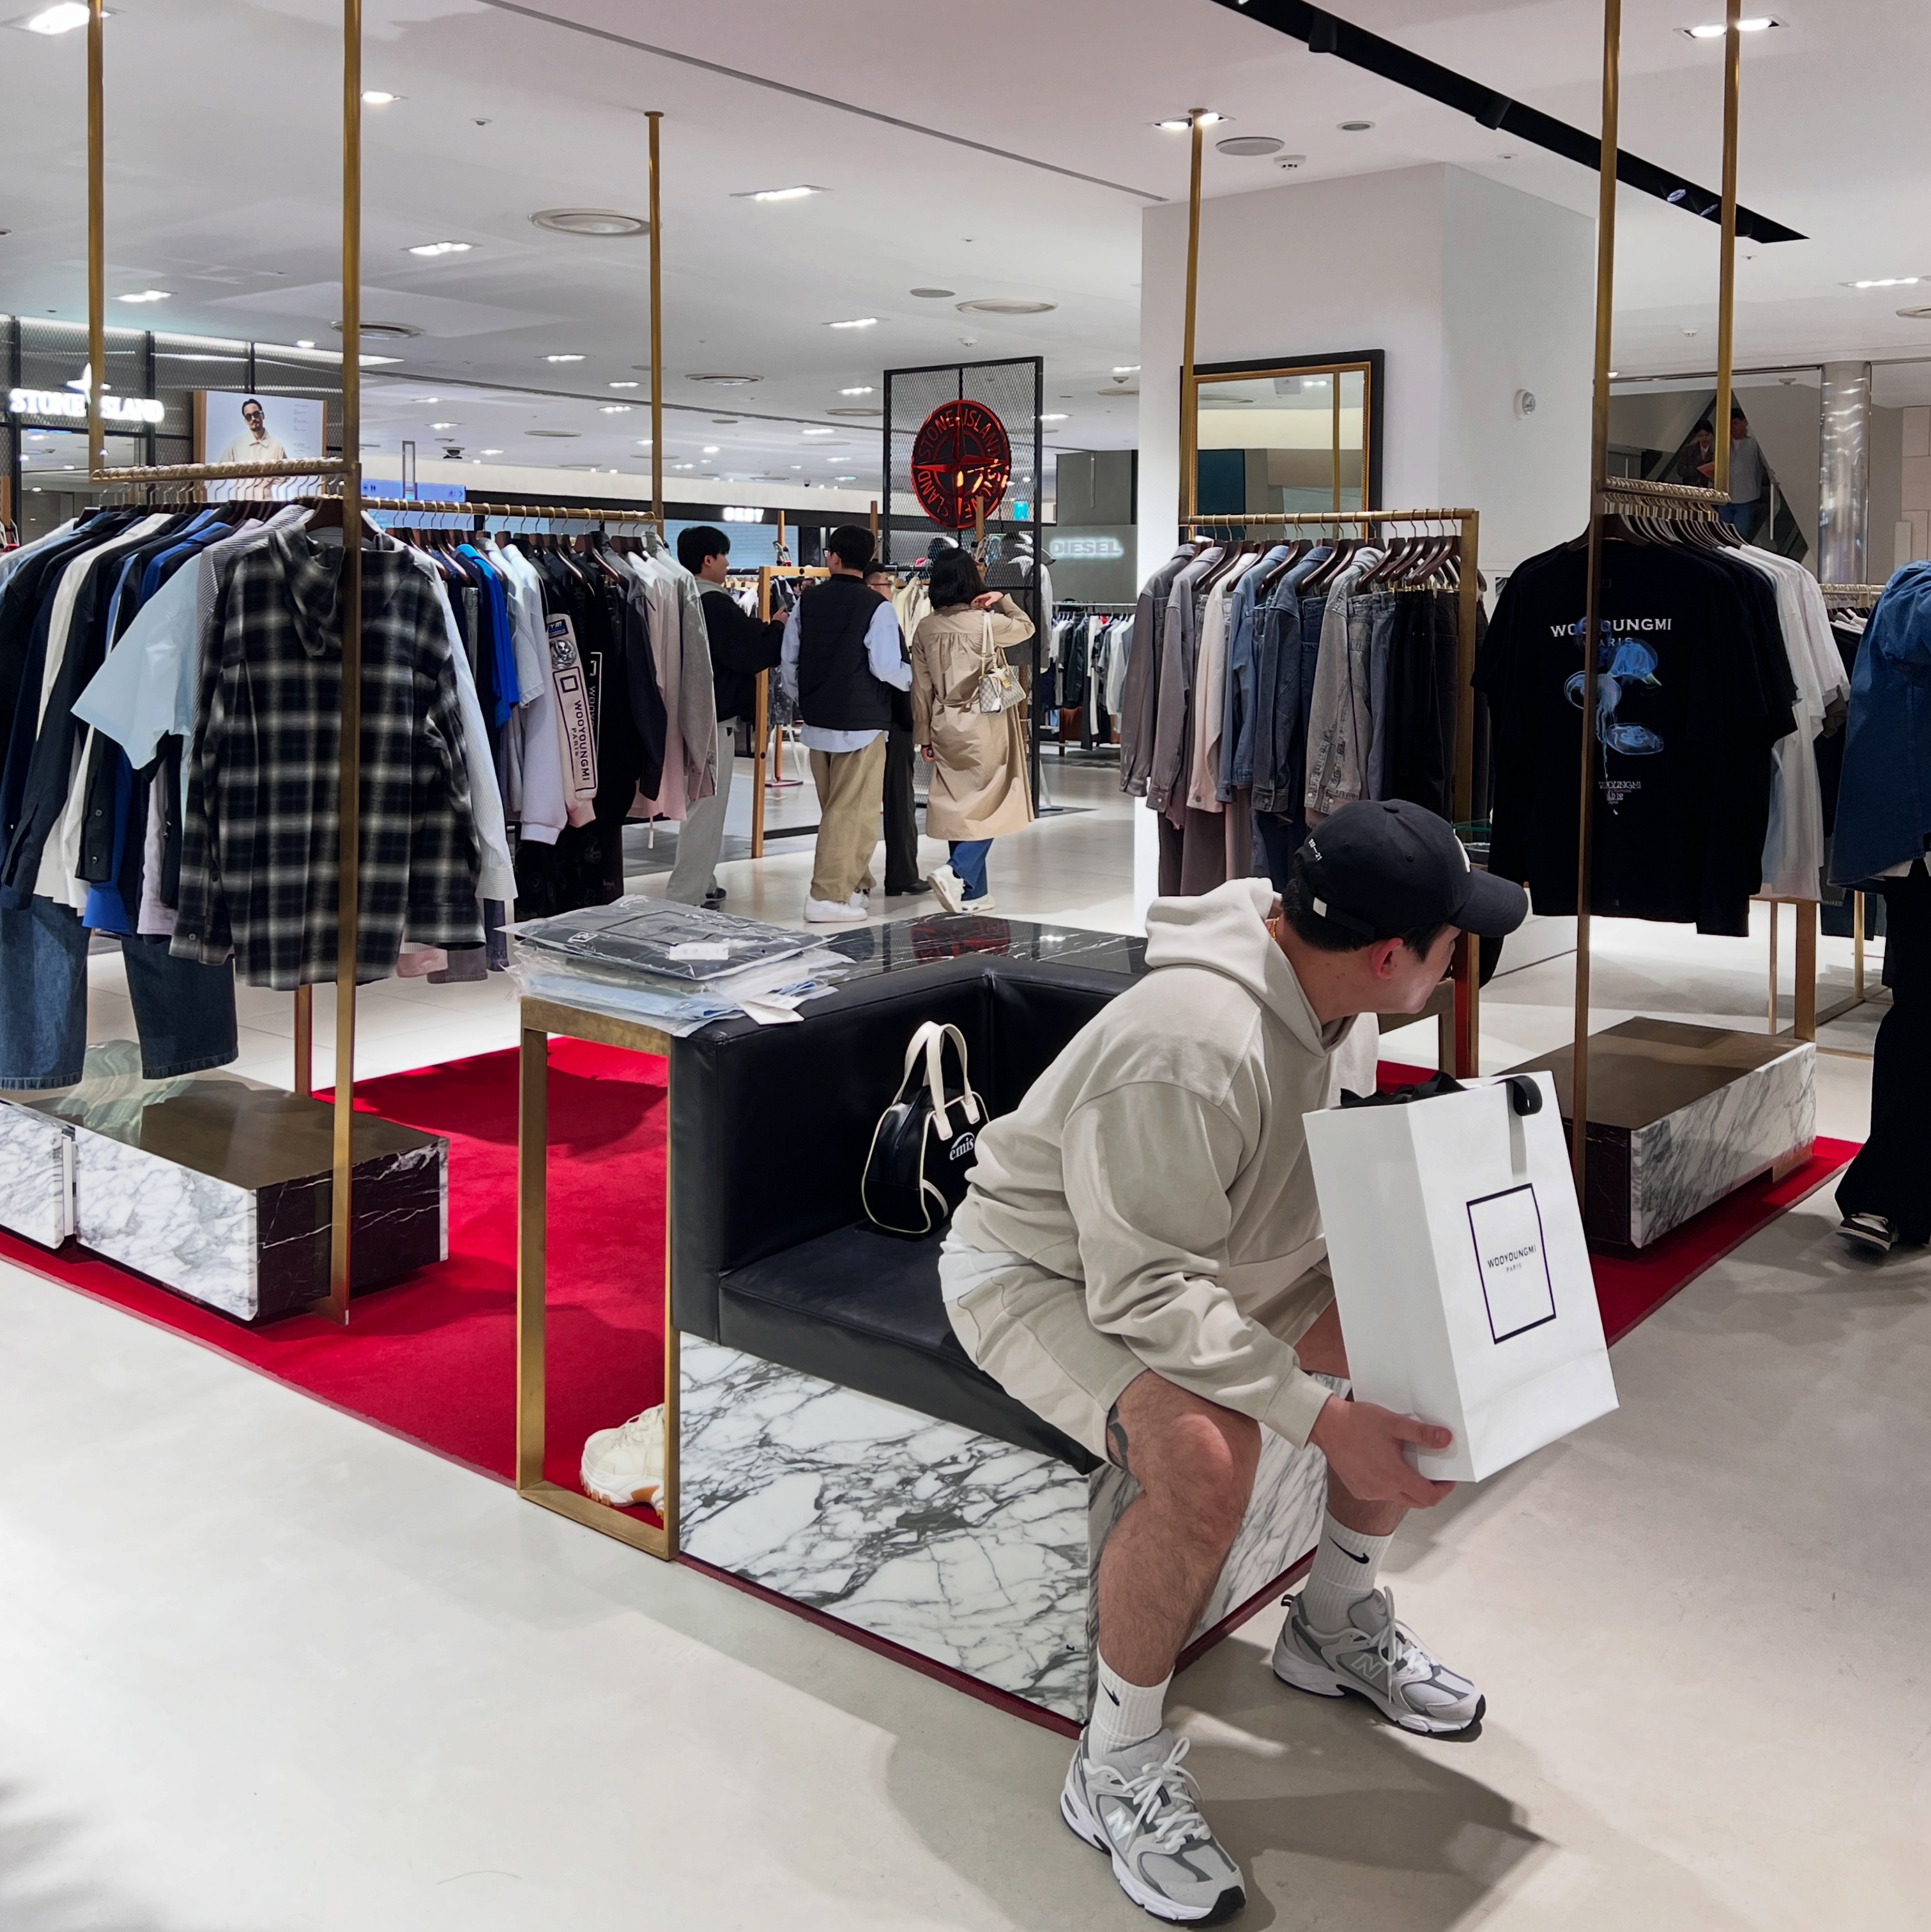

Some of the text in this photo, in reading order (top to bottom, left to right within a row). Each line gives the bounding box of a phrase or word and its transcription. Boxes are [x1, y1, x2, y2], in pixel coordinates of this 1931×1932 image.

[10, 388, 164, 422] STONE SLAND
[918, 408, 1001, 459] STONE ISLAND
[1052, 541, 1120, 554] DIESEL
[574, 700, 590, 781] WOOYOUNGMI
[949, 1137, 973, 1160] emis
[1487, 1244, 1536, 1269] WOOYOUNGMI
[1506, 1262, 1522, 1273] PARIS
